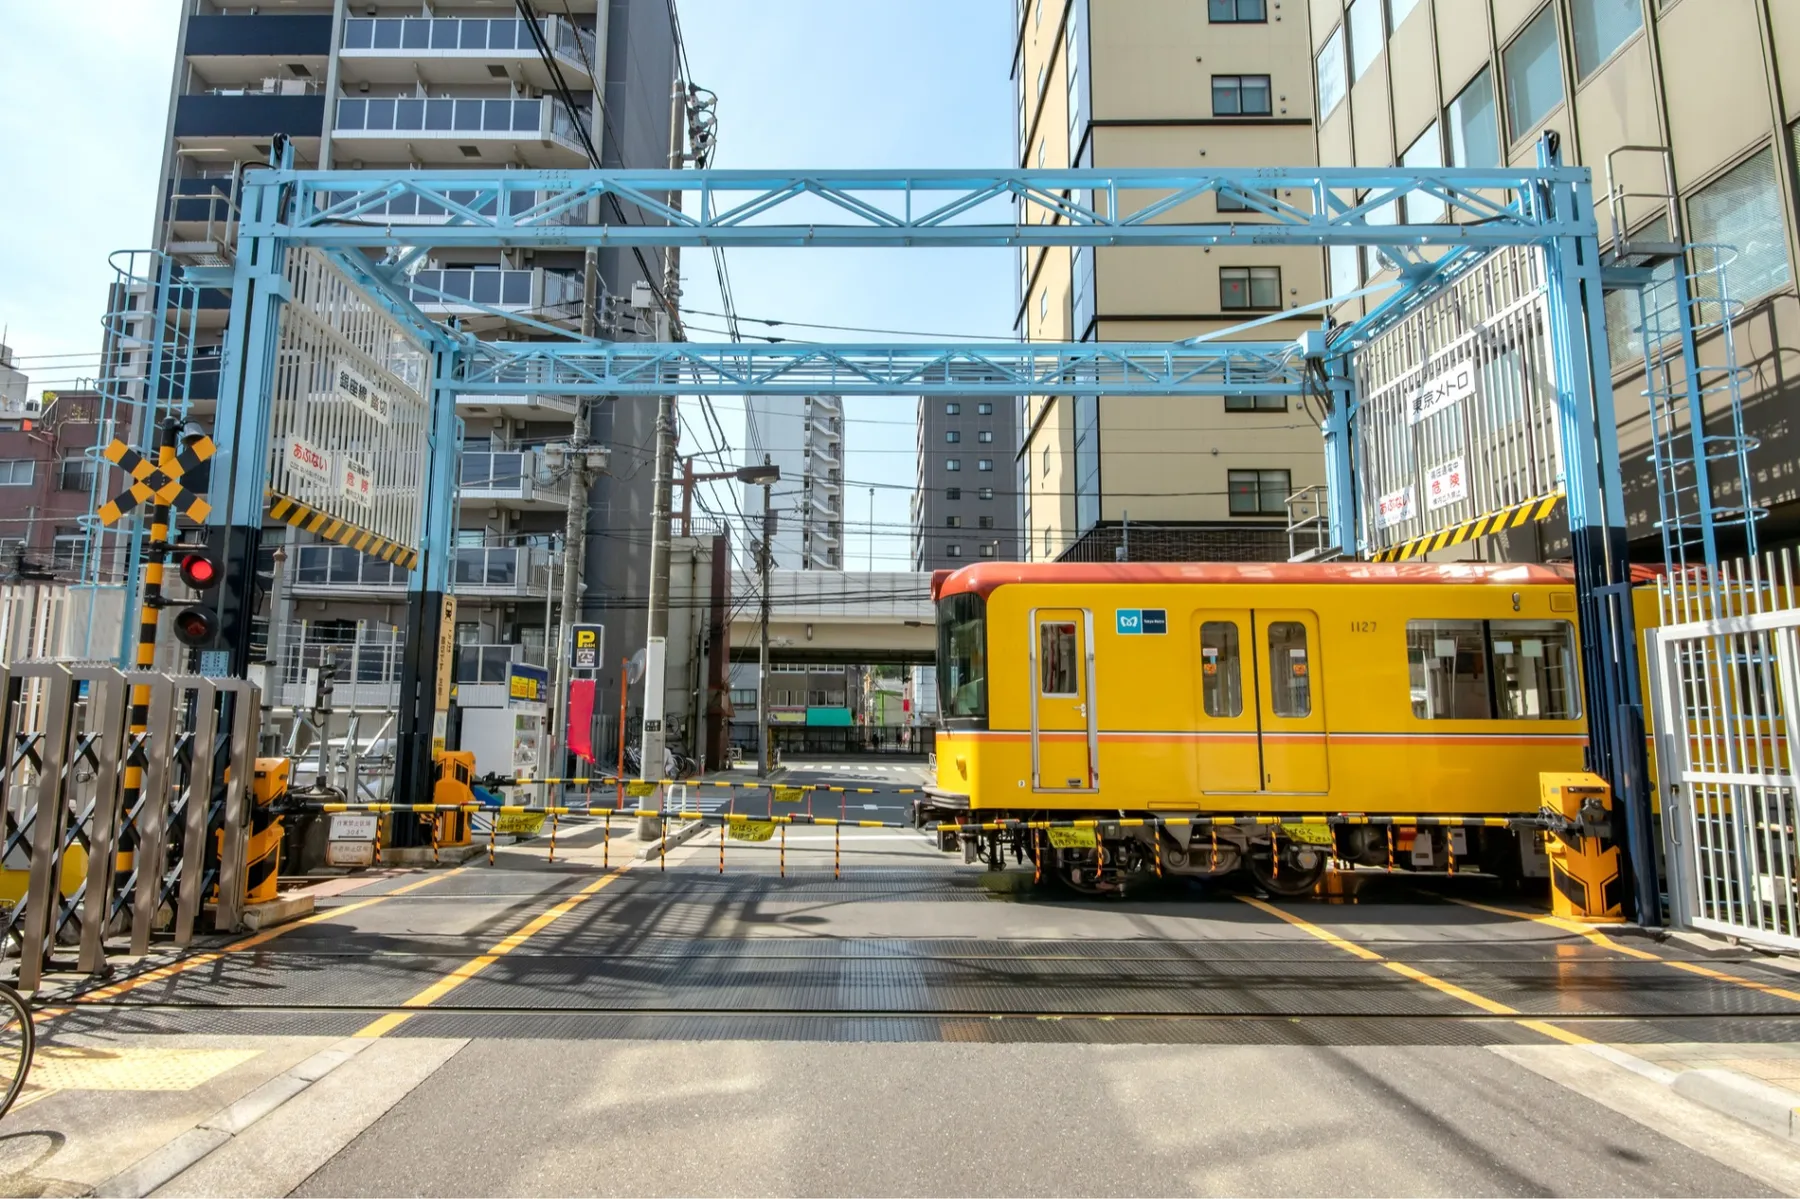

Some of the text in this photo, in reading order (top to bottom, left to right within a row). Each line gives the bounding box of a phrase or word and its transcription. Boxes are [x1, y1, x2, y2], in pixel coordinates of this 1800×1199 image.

[340, 370, 387, 417] 銀座線 踏切
[1412, 371, 1469, 416] 東京メトロ
[293, 442, 328, 471] あぶない
[1432, 472, 1460, 495] 危険
[1380, 493, 1411, 515] あぶない
[1351, 621, 1377, 633] 1127
[577, 630, 596, 648] P
[731, 824, 760, 832] しばらく
